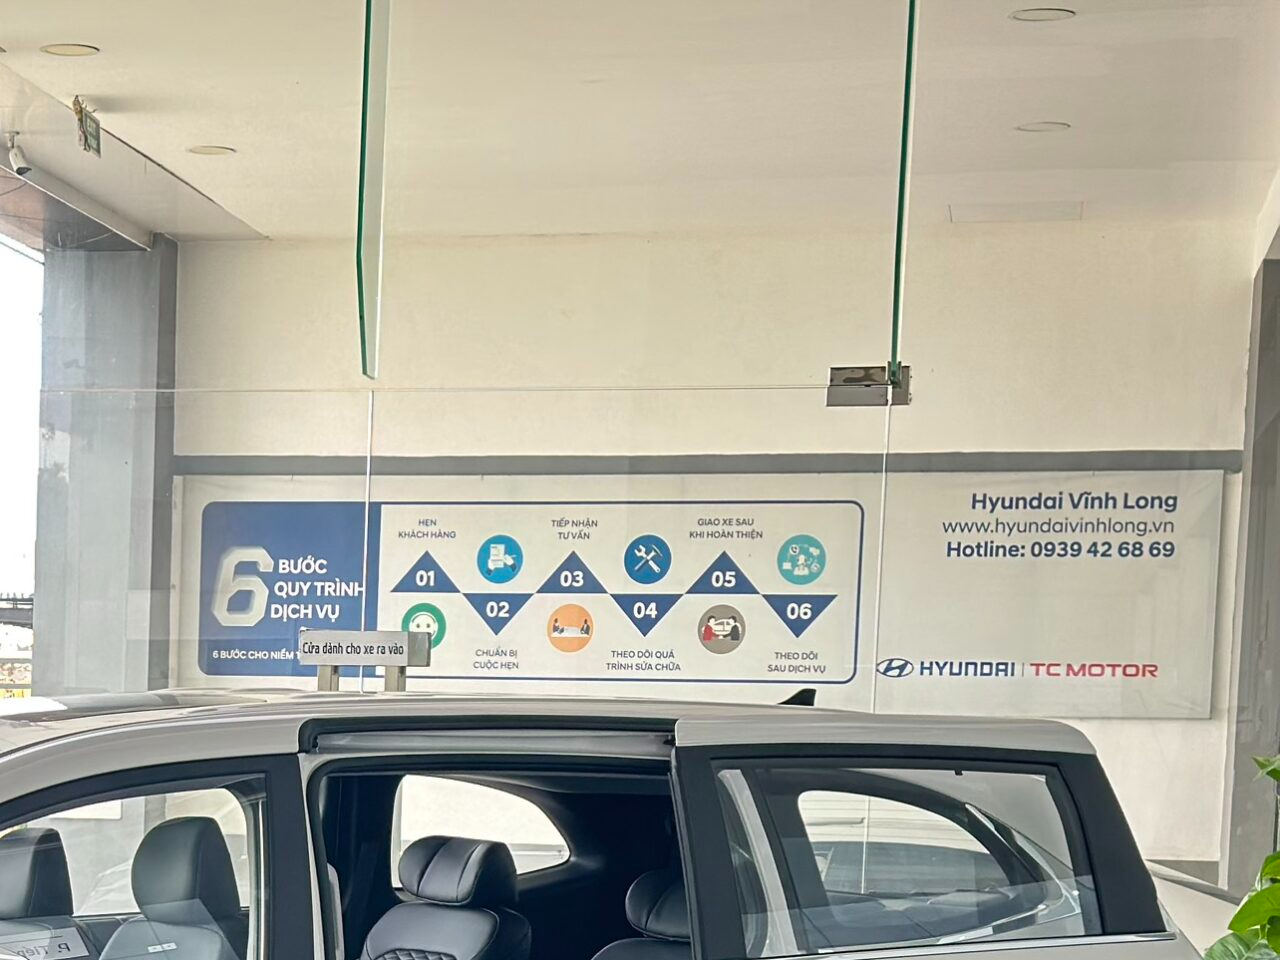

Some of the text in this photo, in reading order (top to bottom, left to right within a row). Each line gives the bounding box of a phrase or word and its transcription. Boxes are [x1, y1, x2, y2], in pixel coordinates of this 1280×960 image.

[972, 491, 1177, 513] Hyundai Vĩnh Long
[418, 518, 437, 527] HẸN
[551, 517, 598, 529] TIẾP NHẬN
[697, 518, 754, 526] GIAO XE SAU
[942, 518, 1174, 536] www.hyundaivinhlong.vn
[398, 529, 456, 539] KHÁCH HÀNG
[570, 529, 590, 540] VẤN
[689, 529, 763, 540] KHI HOÀN THIỆN
[946, 541, 1176, 557] Hotline: 0939 42 68 69
[279, 555, 328, 574] BƯỚC
[415, 570, 435, 586] 01
[560, 571, 584, 587] 03
[711, 571, 736, 587] 05
[211, 547, 274, 626] 6
[274, 577, 365, 598] QUY TRÌNH
[270, 603, 340, 622] DỊCH VỤ
[486, 601, 510, 617] 02
[633, 602, 658, 618] 04
[786, 603, 812, 619] 06
[220, 649, 246, 659] BƯỚC
[248, 651, 269, 659] CHO
[303, 642, 404, 654] Cửa dành cho xe ra vào
[611, 650, 636, 659] THEO
[774, 651, 800, 660] THEO
[473, 660, 519, 670] CUỘC HẸN
[606, 661, 634, 671] TRÌNH
[767, 664, 826, 674] SAU DỊCH VỤ
[920, 661, 1158, 677] HYUNDAI TC MOTOR
